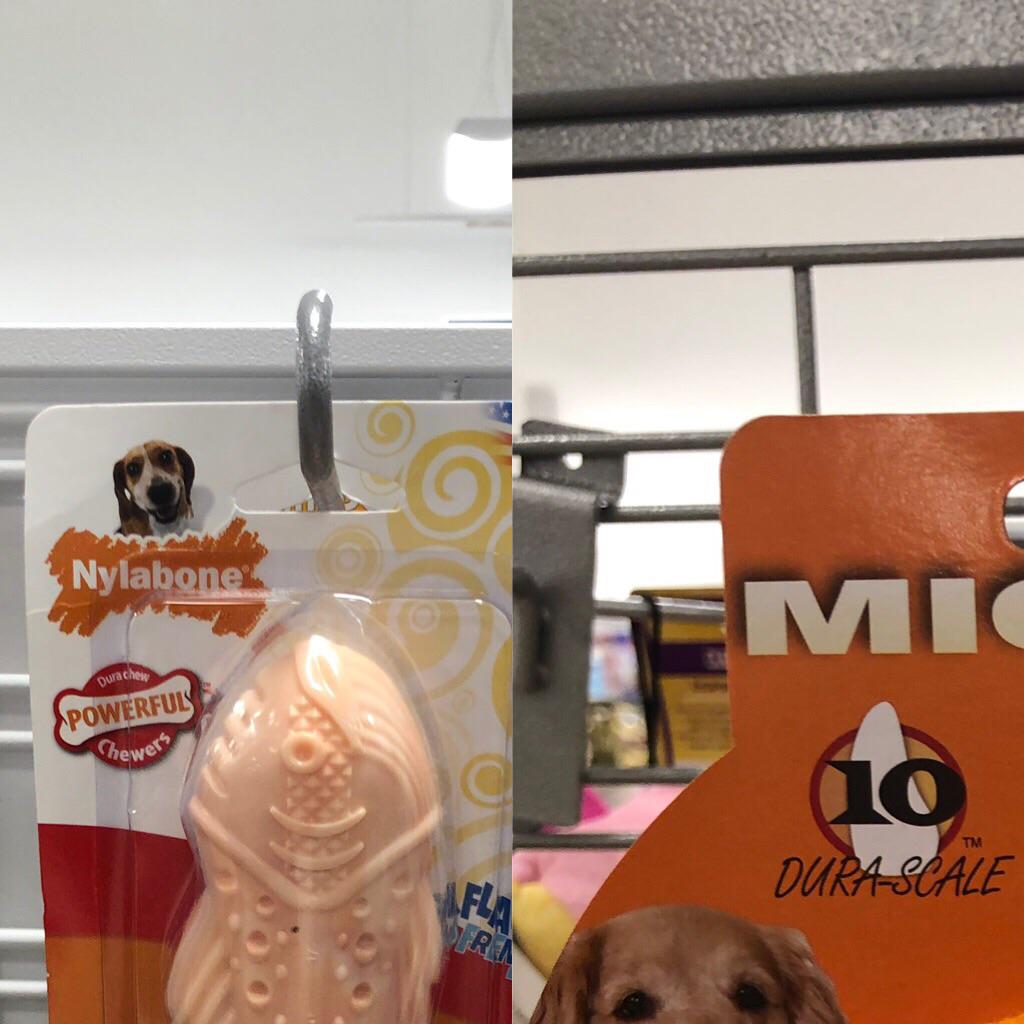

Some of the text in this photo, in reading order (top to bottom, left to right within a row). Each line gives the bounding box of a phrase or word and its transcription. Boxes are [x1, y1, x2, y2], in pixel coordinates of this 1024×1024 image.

[73, 560, 243, 597] Nylabone
[66, 691, 190, 732] POWERFUL
[98, 732, 170, 762] Chewers
[825, 758, 966, 826] 10
[774, 855, 1015, 898] DURA-SCALE
